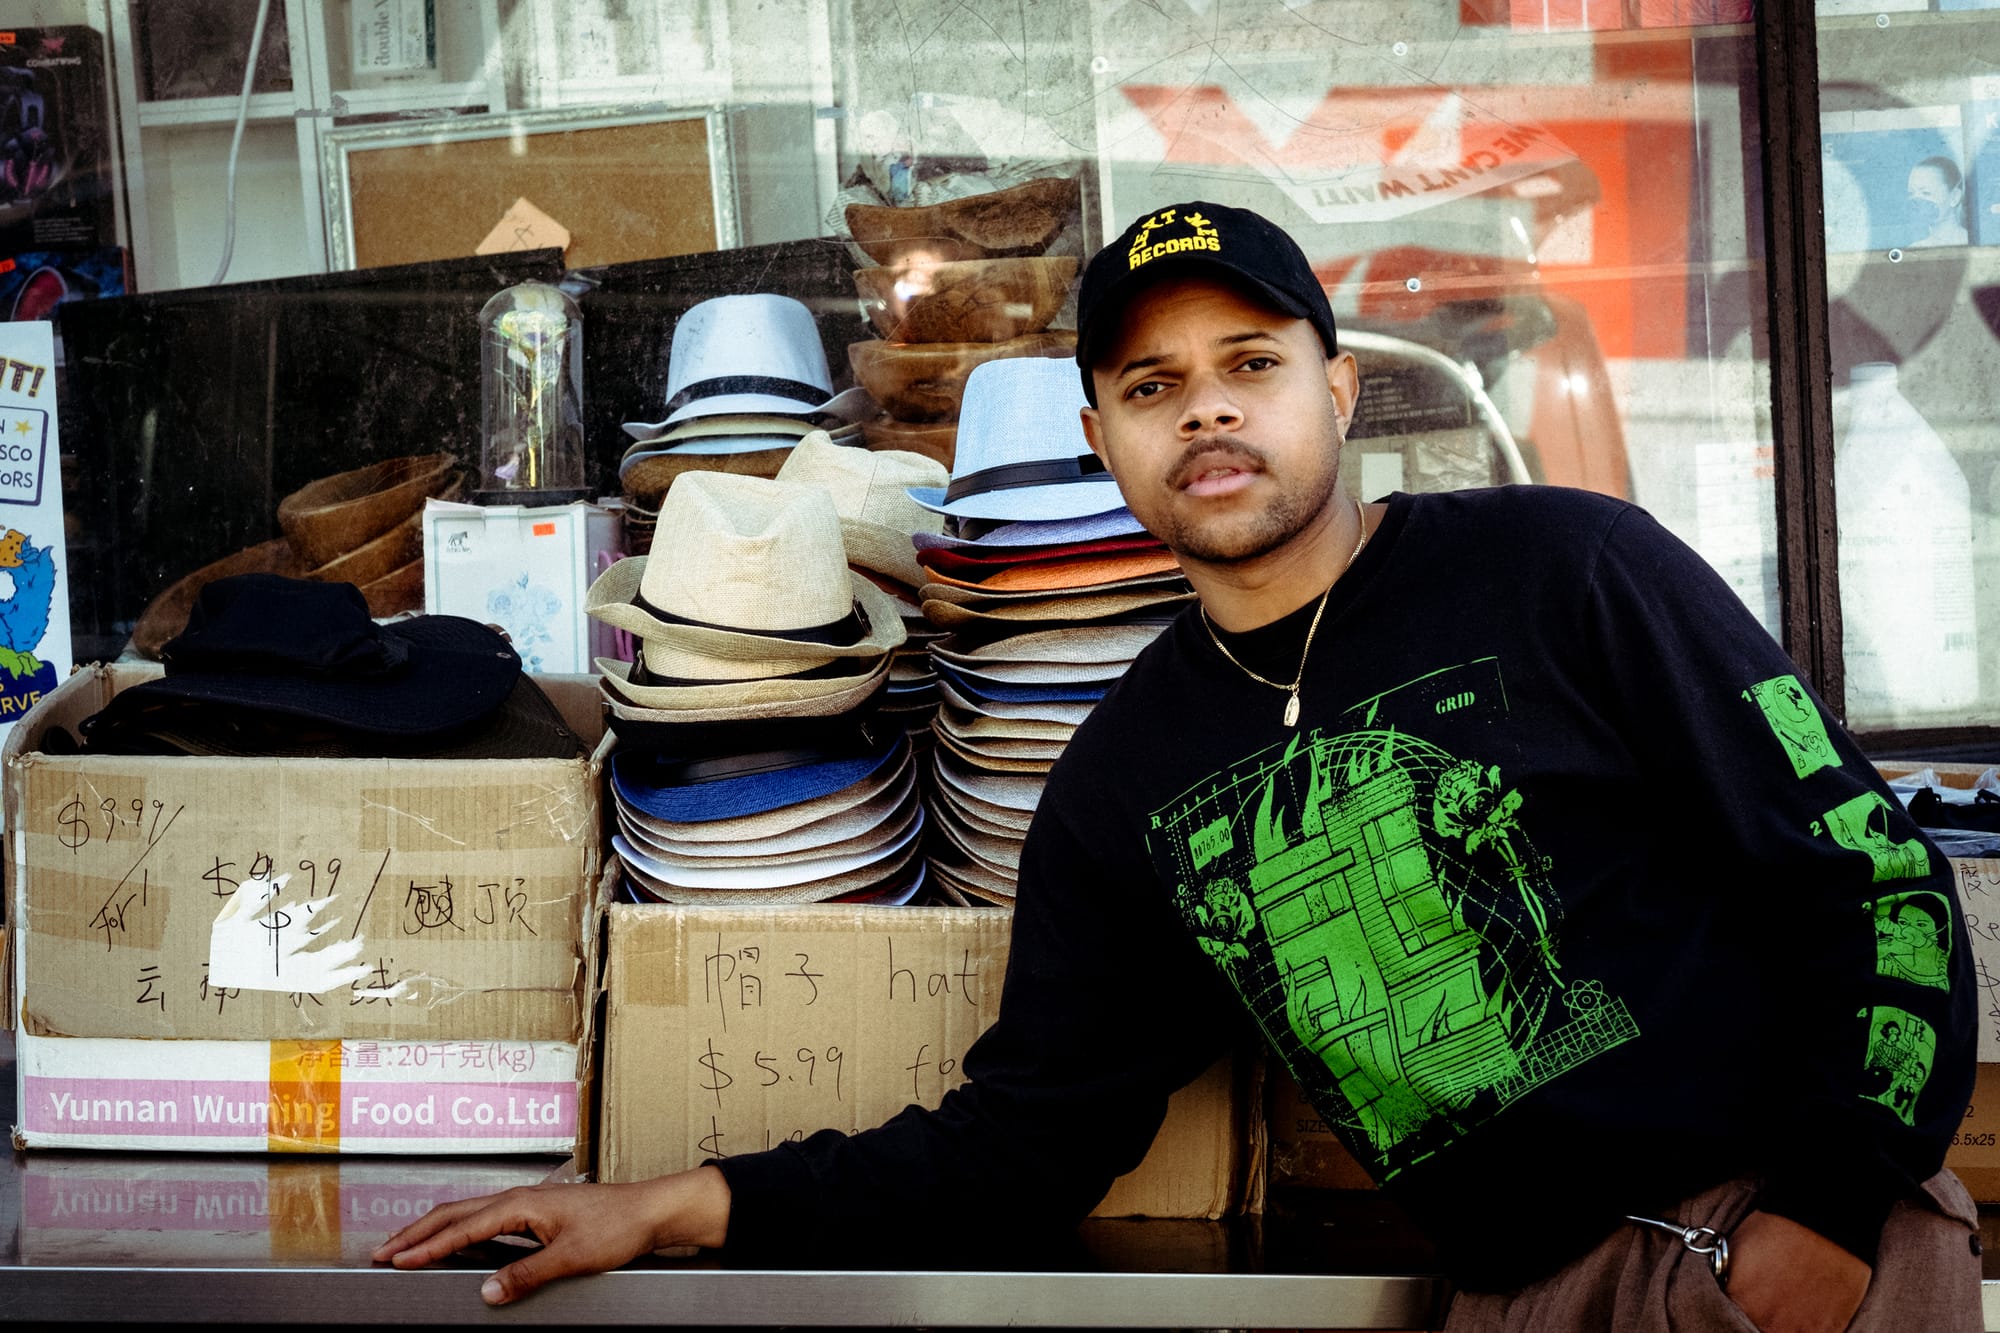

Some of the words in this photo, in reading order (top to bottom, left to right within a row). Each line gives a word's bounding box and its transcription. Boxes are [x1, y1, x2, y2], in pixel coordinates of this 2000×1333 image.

[373, 11, 391, 66] double
[1492, 124, 1546, 157] WE
[1417, 150, 1501, 192] CAN'T
[1128, 235, 1221, 270] RECORDS
[0, 690, 41, 717] RVE
[1435, 691, 1476, 715] GRID
[1741, 690, 1753, 703] 1
[1150, 815, 1162, 830] R
[1809, 820, 1823, 837] 2
[97, 893, 137, 953] for
[705, 932, 824, 1033] 帽子
[887, 936, 979, 1006] hat
[1856, 1007, 1868, 1018] 4
[50, 1092, 178, 1124] Yunnan
[192, 1093, 336, 1133] Wuming
[351, 1095, 435, 1125] Food
[451, 1095, 561, 1125] Co.Ltd
[1951, 1133, 1996, 1146] 6.5x25
